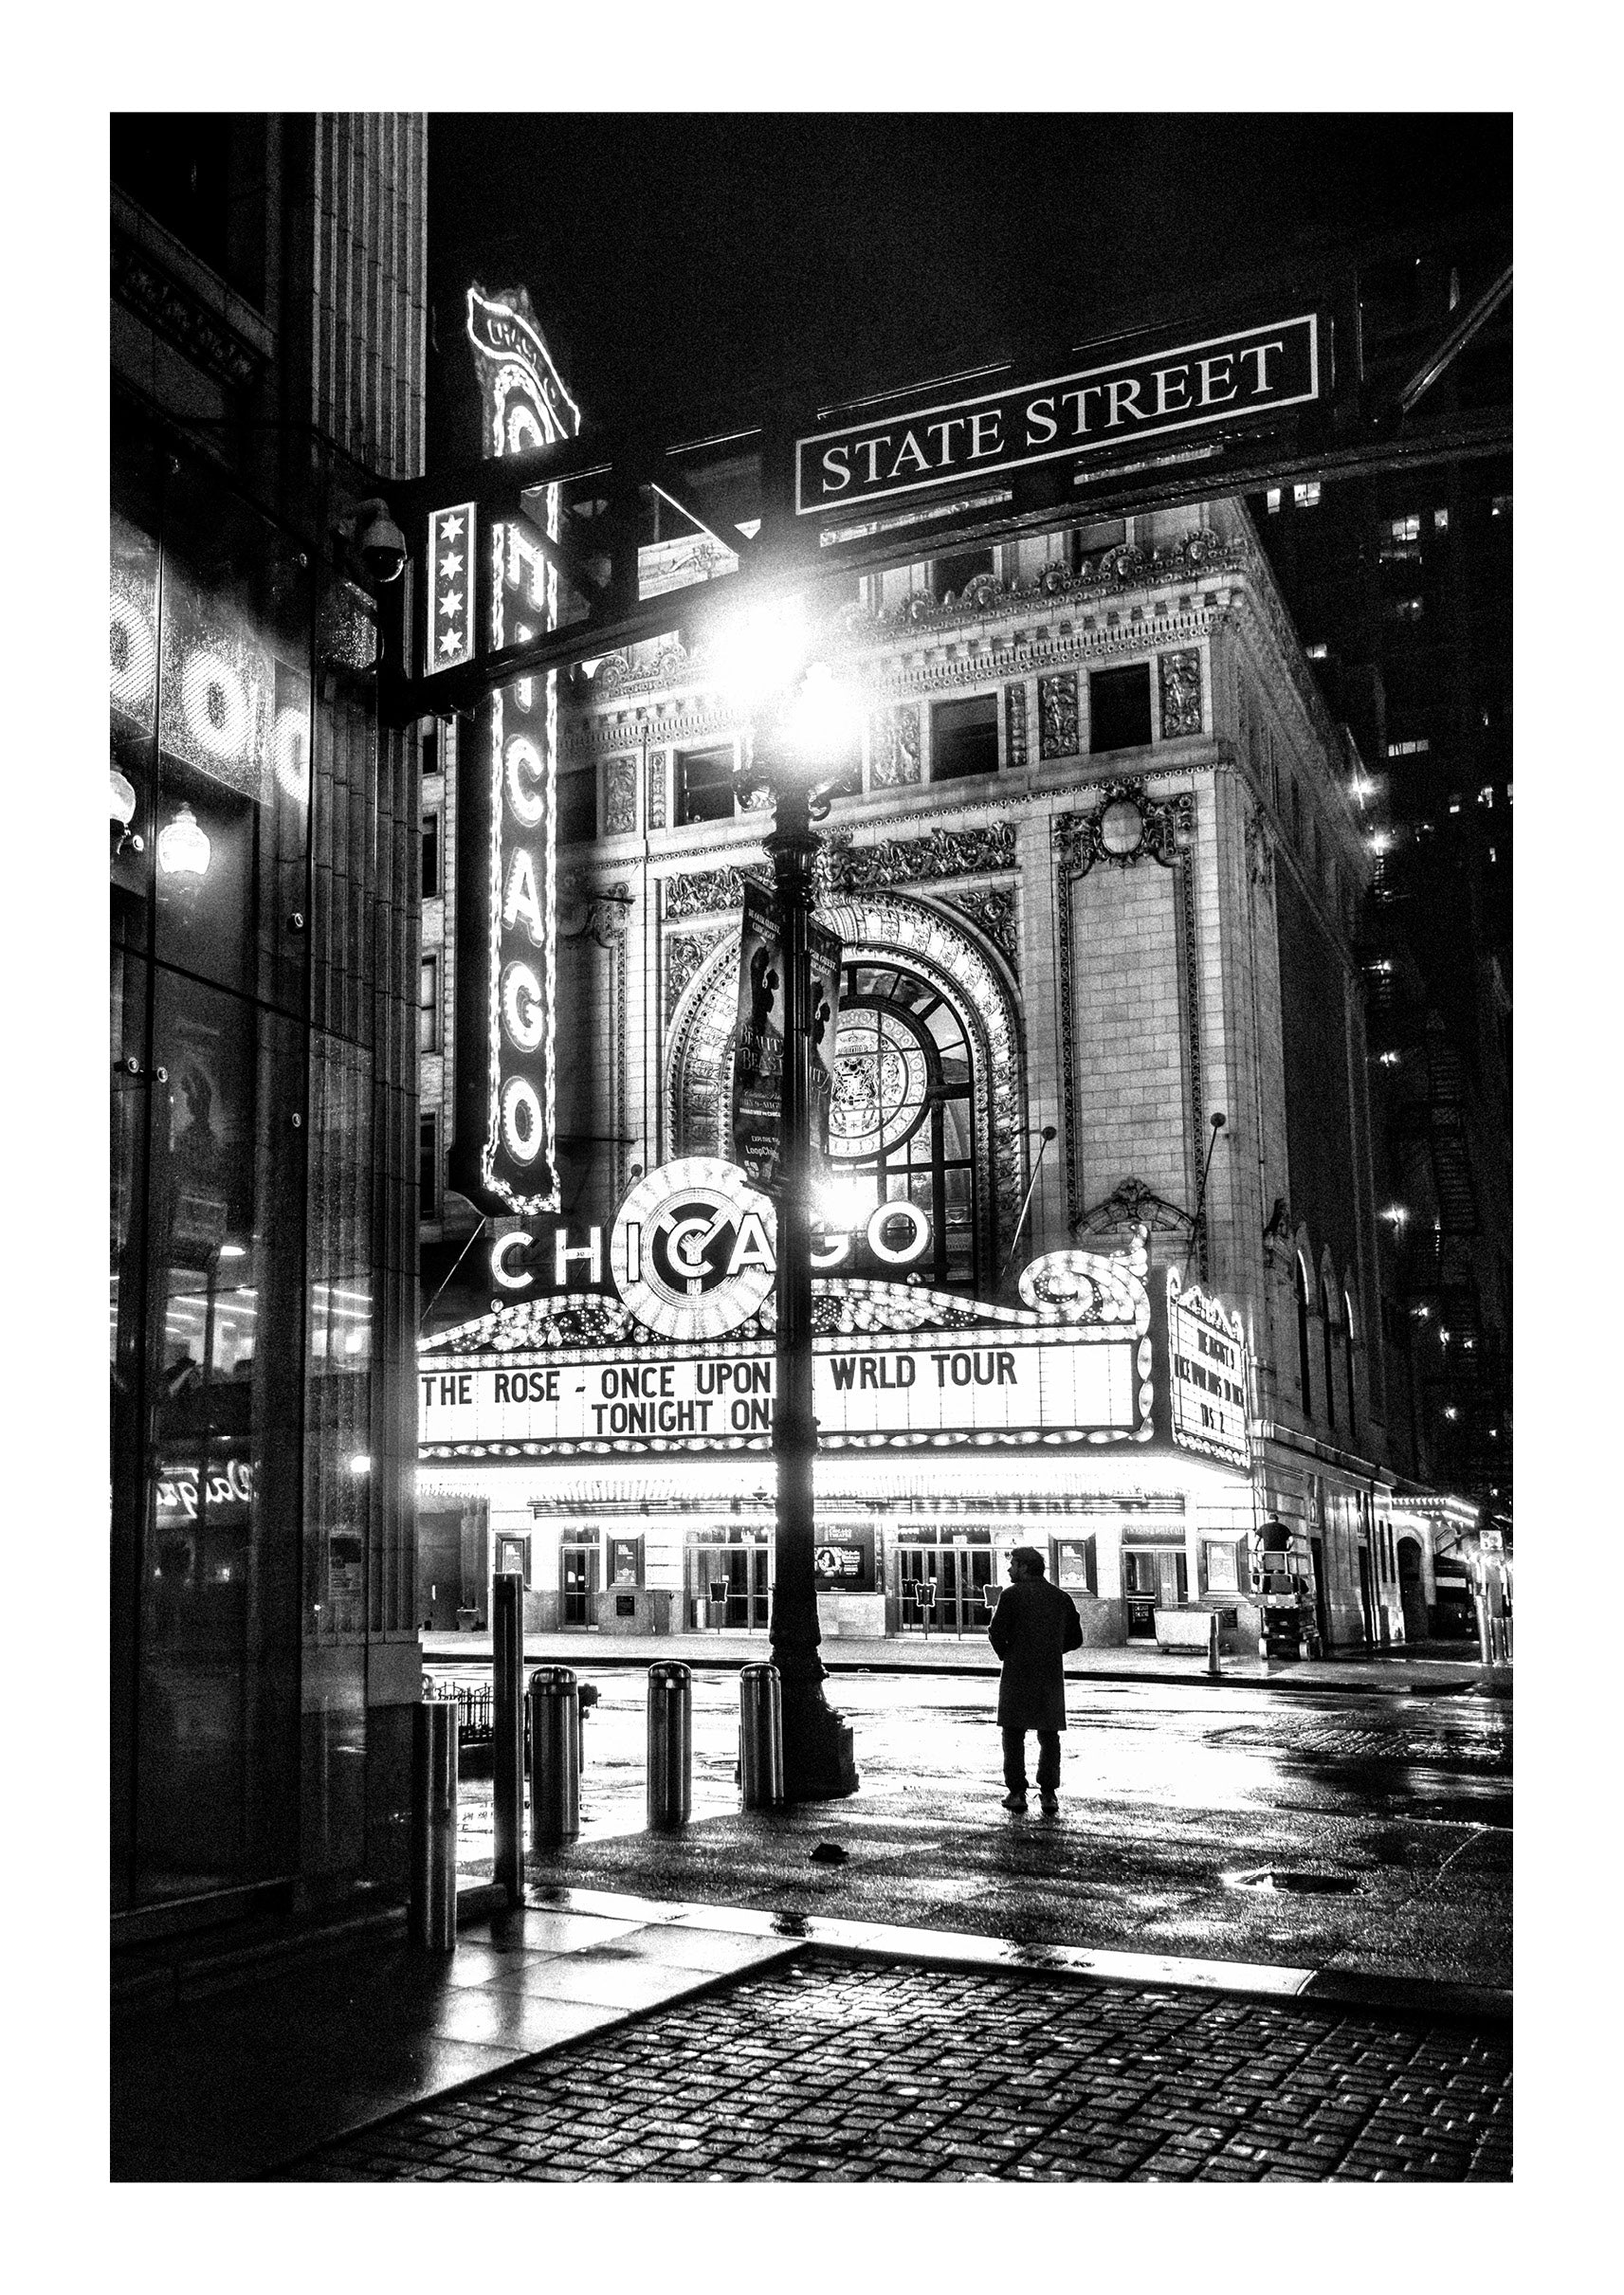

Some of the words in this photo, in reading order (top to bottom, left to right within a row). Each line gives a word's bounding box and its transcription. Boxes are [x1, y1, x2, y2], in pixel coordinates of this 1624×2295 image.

[821, 409, 1006, 493] STATE
[1025, 341, 1284, 446] STREET
[421, 1375, 472, 1406] THE
[494, 1370, 560, 1403] ROSE
[601, 1365, 675, 1399] ONCE
[697, 1361, 771, 1395] UPON
[830, 1355, 916, 1391] WRLD
[930, 1351, 1018, 1388] TOUR
[591, 1400, 714, 1435] TONIGHT
[731, 1397, 776, 1431] ON
